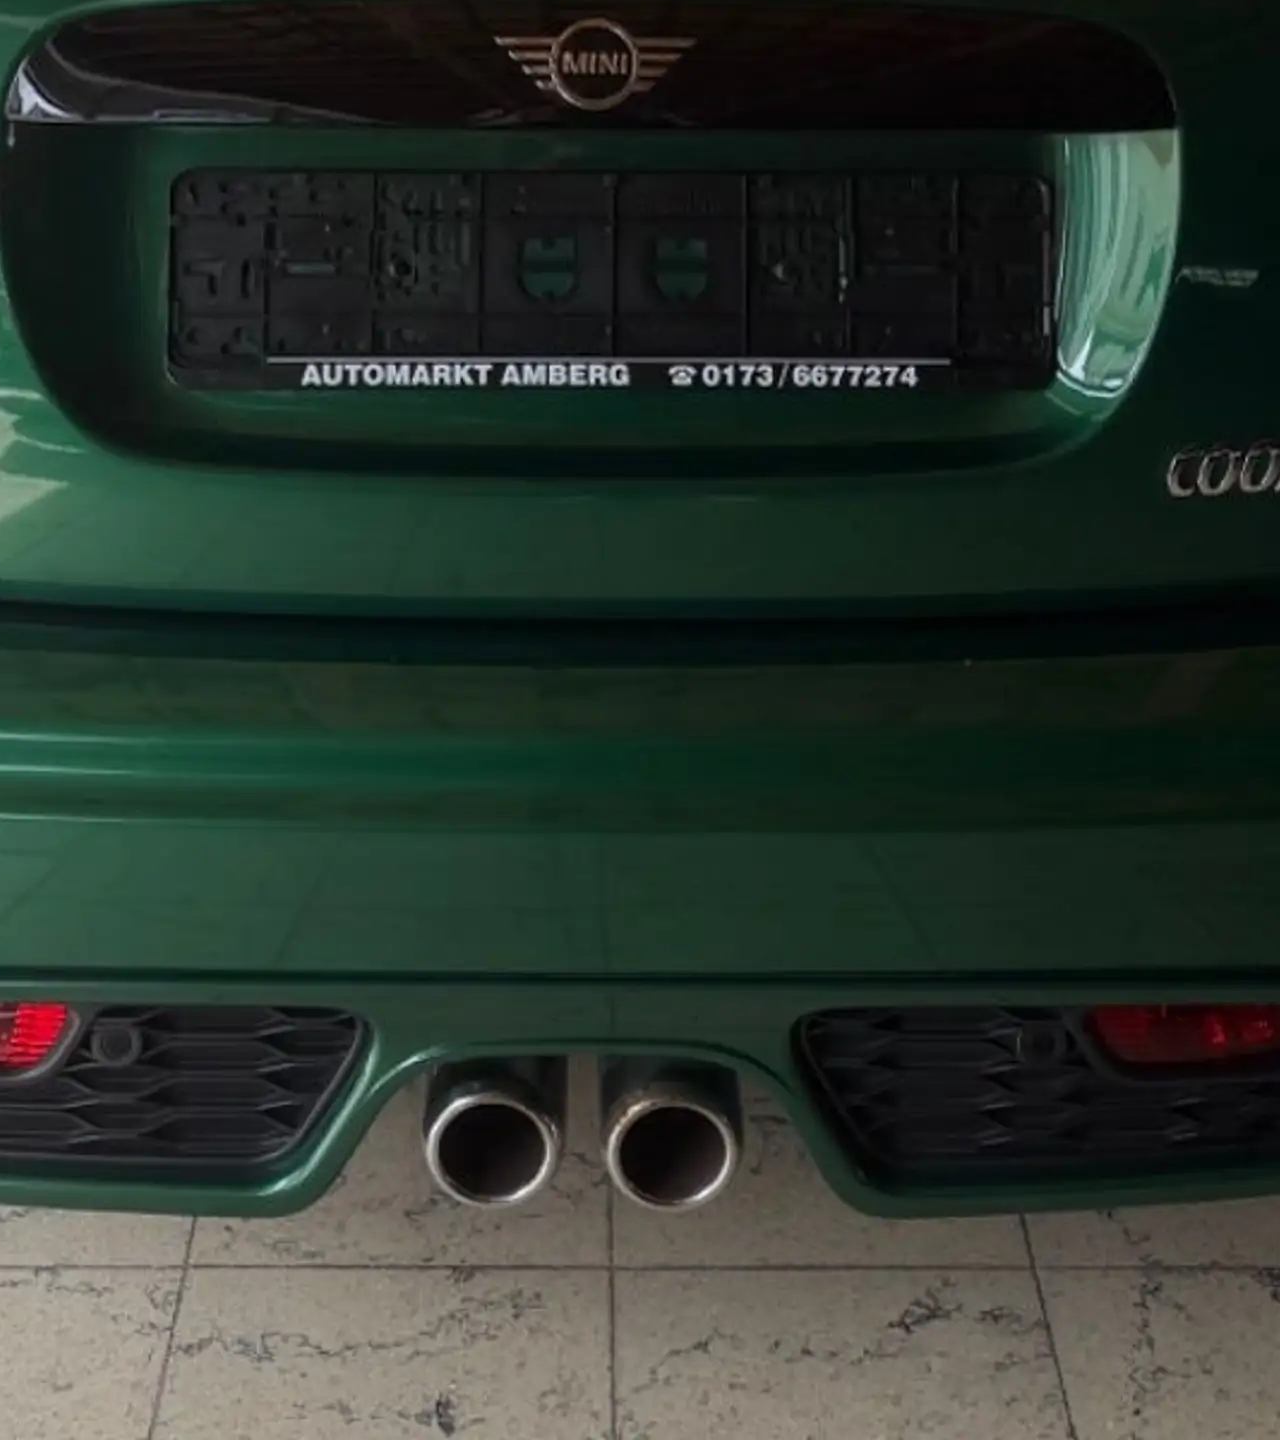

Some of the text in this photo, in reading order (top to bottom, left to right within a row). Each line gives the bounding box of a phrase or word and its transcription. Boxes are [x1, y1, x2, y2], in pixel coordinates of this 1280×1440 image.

[562, 49, 629, 76] MINI
[301, 363, 493, 387] AUTOMARKT
[500, 363, 631, 388] AMBERG
